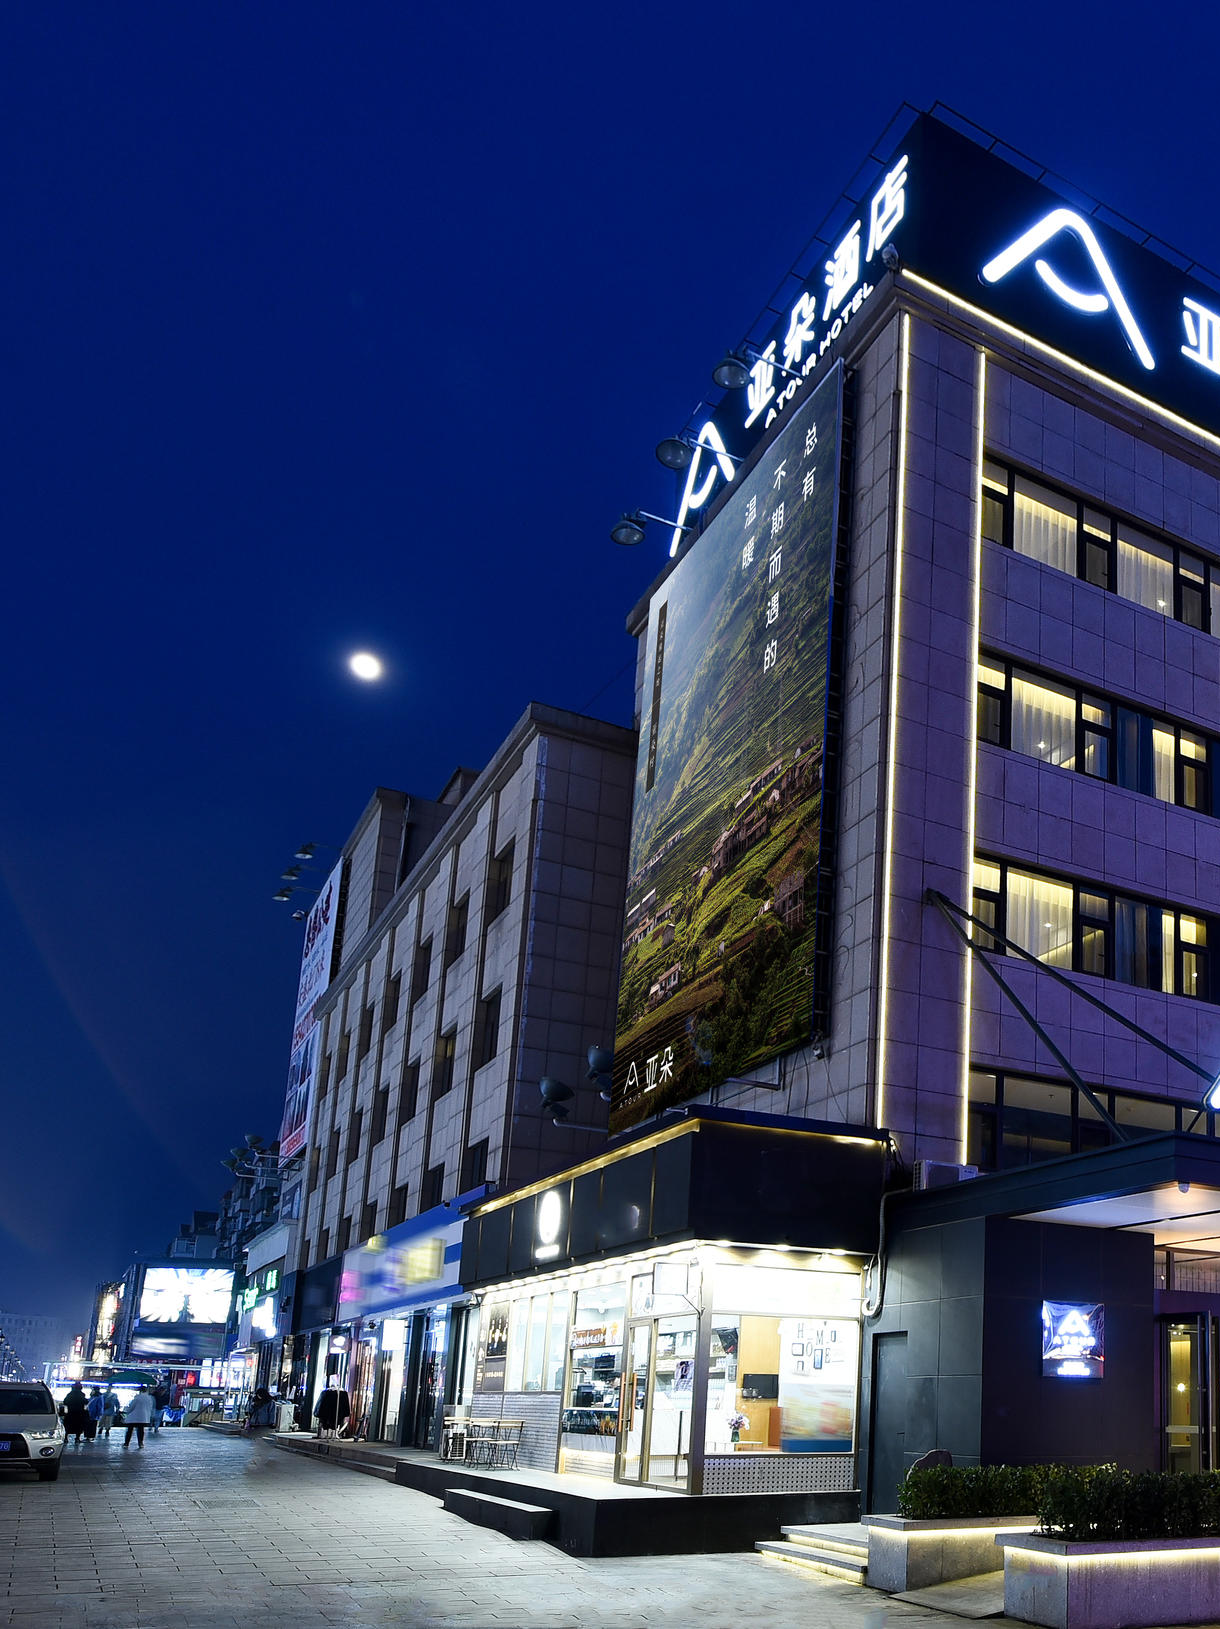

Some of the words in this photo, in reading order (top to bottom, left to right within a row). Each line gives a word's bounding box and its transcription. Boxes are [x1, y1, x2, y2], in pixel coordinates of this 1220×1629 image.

[744, 155, 909, 429] 亚朵酒店
[765, 352, 816, 429] ATOUR
[820, 282, 874, 356] HOTEL
[803, 422, 818, 502] 总有
[741, 494, 757, 570] 温暖
[762, 458, 787, 674] 不期而遇的
[643, 1046, 674, 1094] 亚朵
